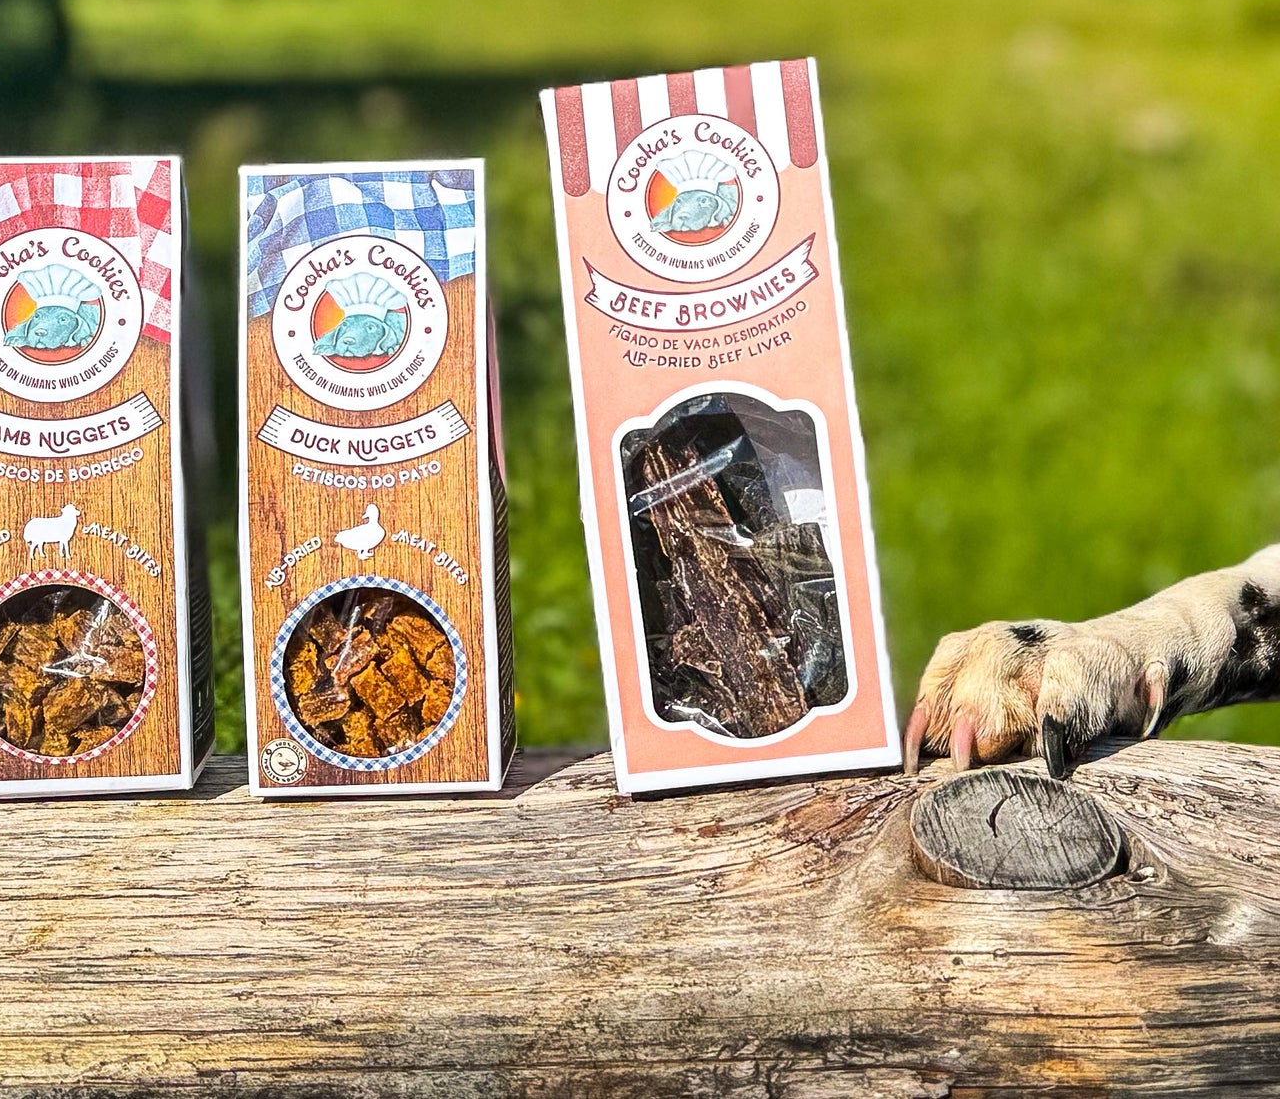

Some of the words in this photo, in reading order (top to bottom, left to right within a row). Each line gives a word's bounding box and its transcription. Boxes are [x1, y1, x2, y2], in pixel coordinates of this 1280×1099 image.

[617, 129, 683, 193] Cooka's
[694, 121, 762, 179] Cookies
[632, 232, 658, 258] TESTED
[656, 252, 667, 265] ON
[668, 257, 705, 270] HUMANS
[706, 253, 726, 267] WHO
[725, 241, 746, 260] LOVE
[284, 249, 356, 312] Cooka's
[609, 291, 667, 320] BEEF
[675, 267, 796, 326] BROWNIES
[608, 324, 659, 349] FÍGADO
[662, 339, 679, 350] DE
[684, 338, 720, 351] VACA
[724, 301, 807, 346] DESIDRATADO
[623, 350, 702, 368] AIR-DRIED
[707, 348, 743, 369] BEEF
[748, 331, 793, 358] LIVER
[6, 368, 19, 381] ON
[19, 374, 57, 390] HUMANS
[58, 375, 80, 389] WHO
[81, 363, 102, 382] LOVE
[293, 353, 318, 382] TESTED
[316, 378, 328, 390] ON
[328, 382, 365, 398] HUMANS
[366, 383, 387, 398] WHO
[387, 372, 409, 390] LOVE
[39, 416, 131, 454] NUGGETS
[290, 428, 340, 454] DUCK
[348, 424, 437, 462] NUGGETS
[44, 469, 64, 483] DE
[68, 447, 144, 482] BORREGO
[292, 463, 367, 490] PETISCOS
[371, 473, 396, 489] DO
[399, 460, 442, 485] PATO
[81, 522, 129, 548] MEAT
[125, 545, 162, 579] BITES
[264, 536, 322, 592] AIR-DRIED
[391, 529, 437, 555] MEAT
[434, 552, 469, 586] BITES
